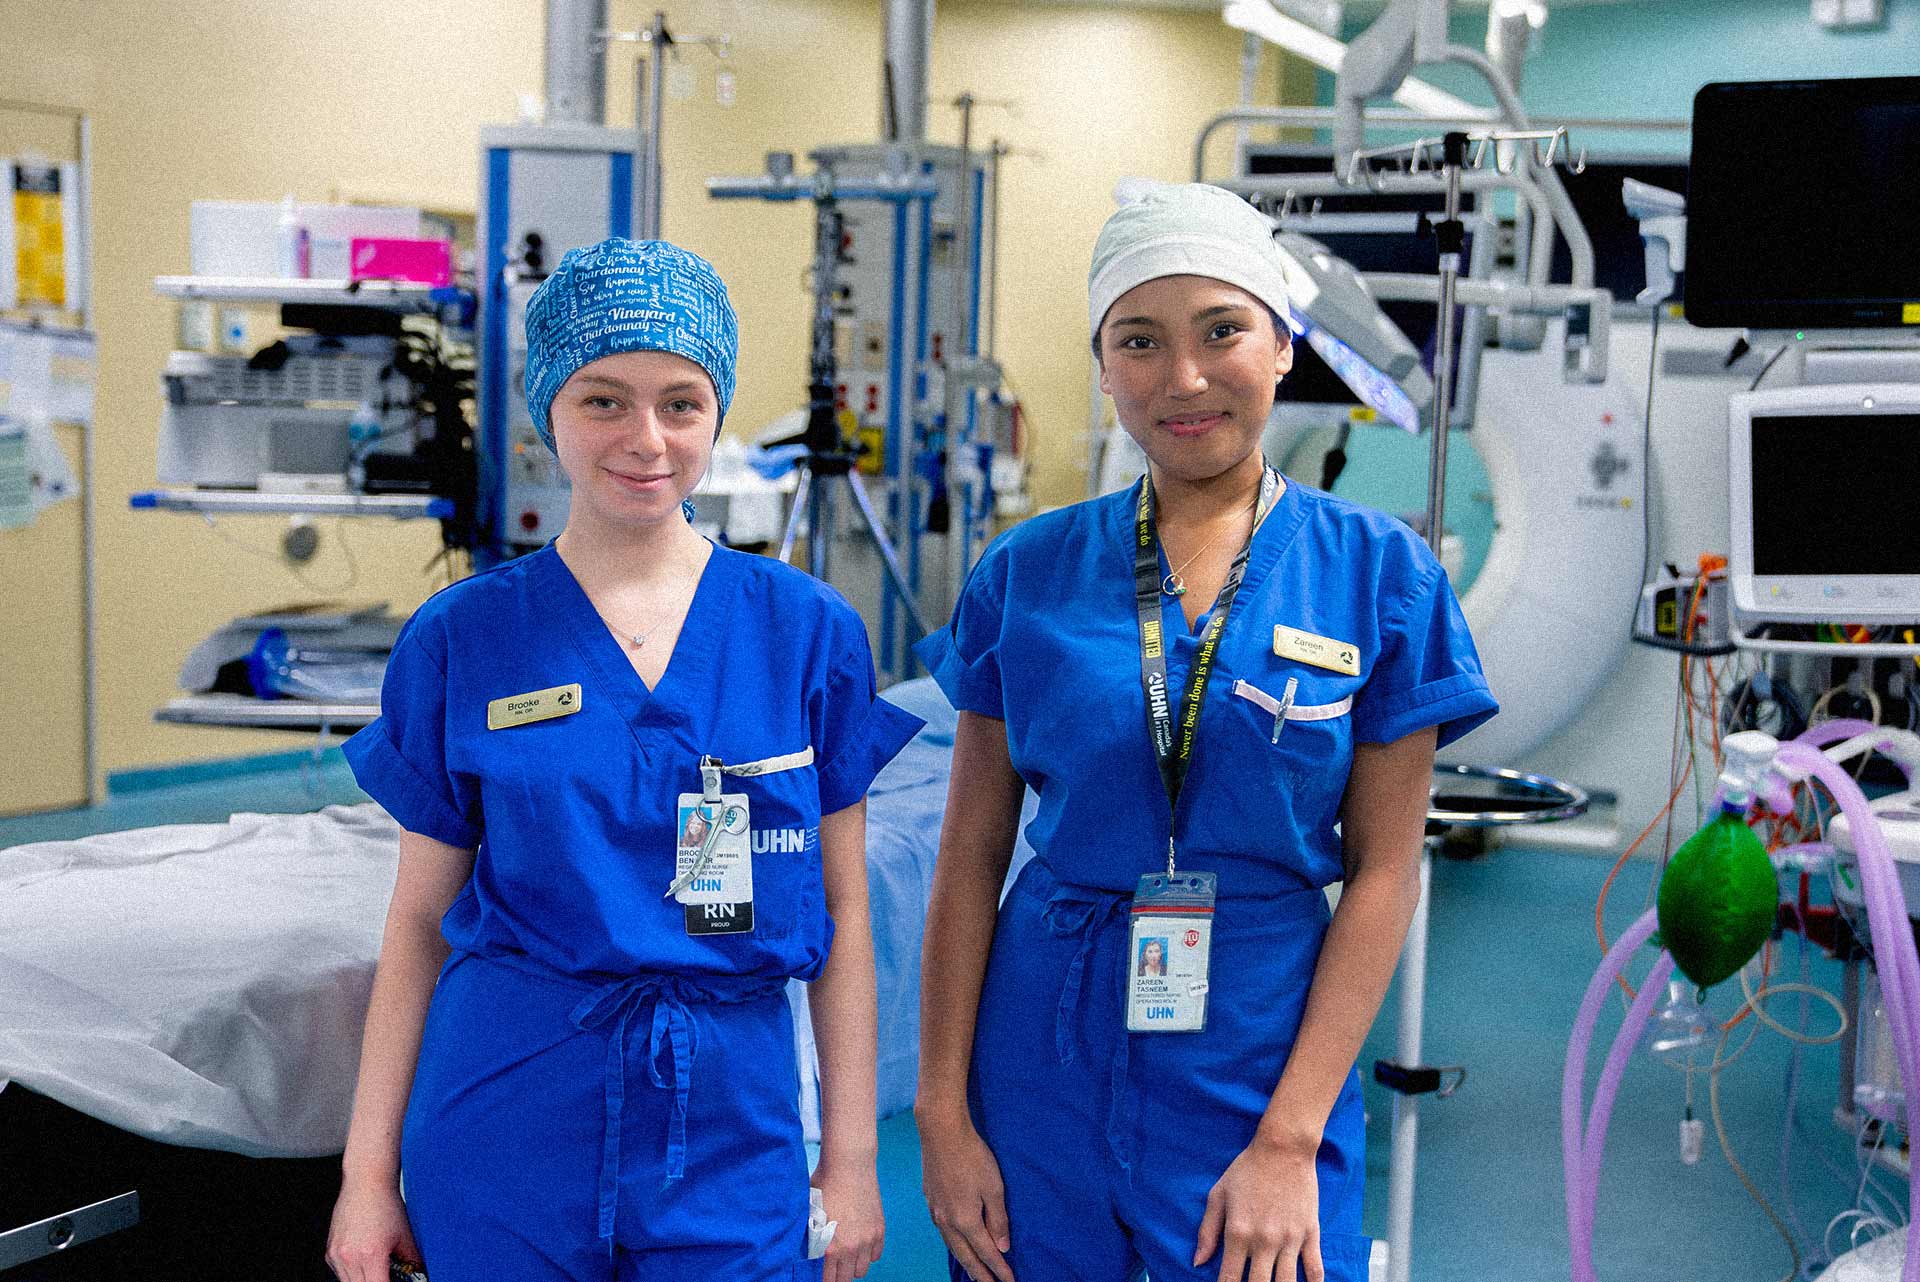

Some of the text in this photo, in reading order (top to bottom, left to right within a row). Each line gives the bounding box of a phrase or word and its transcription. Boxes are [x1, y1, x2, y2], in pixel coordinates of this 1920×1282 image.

[575, 266, 645, 283] Chardonnay
[608, 307, 677, 324] Vineyard
[579, 320, 650, 344] Chardonnay
[1140, 535, 1151, 546] do
[1294, 637, 1324, 651] Zareen
[1180, 616, 1225, 761] Never been done is what we do
[508, 699, 540, 711] Brooke
[1149, 683, 1169, 718] UHN
[752, 829, 805, 854] UHN
[690, 879, 721, 892] UHN
[704, 903, 735, 919] RN
[1146, 1006, 1175, 1019] UHN
